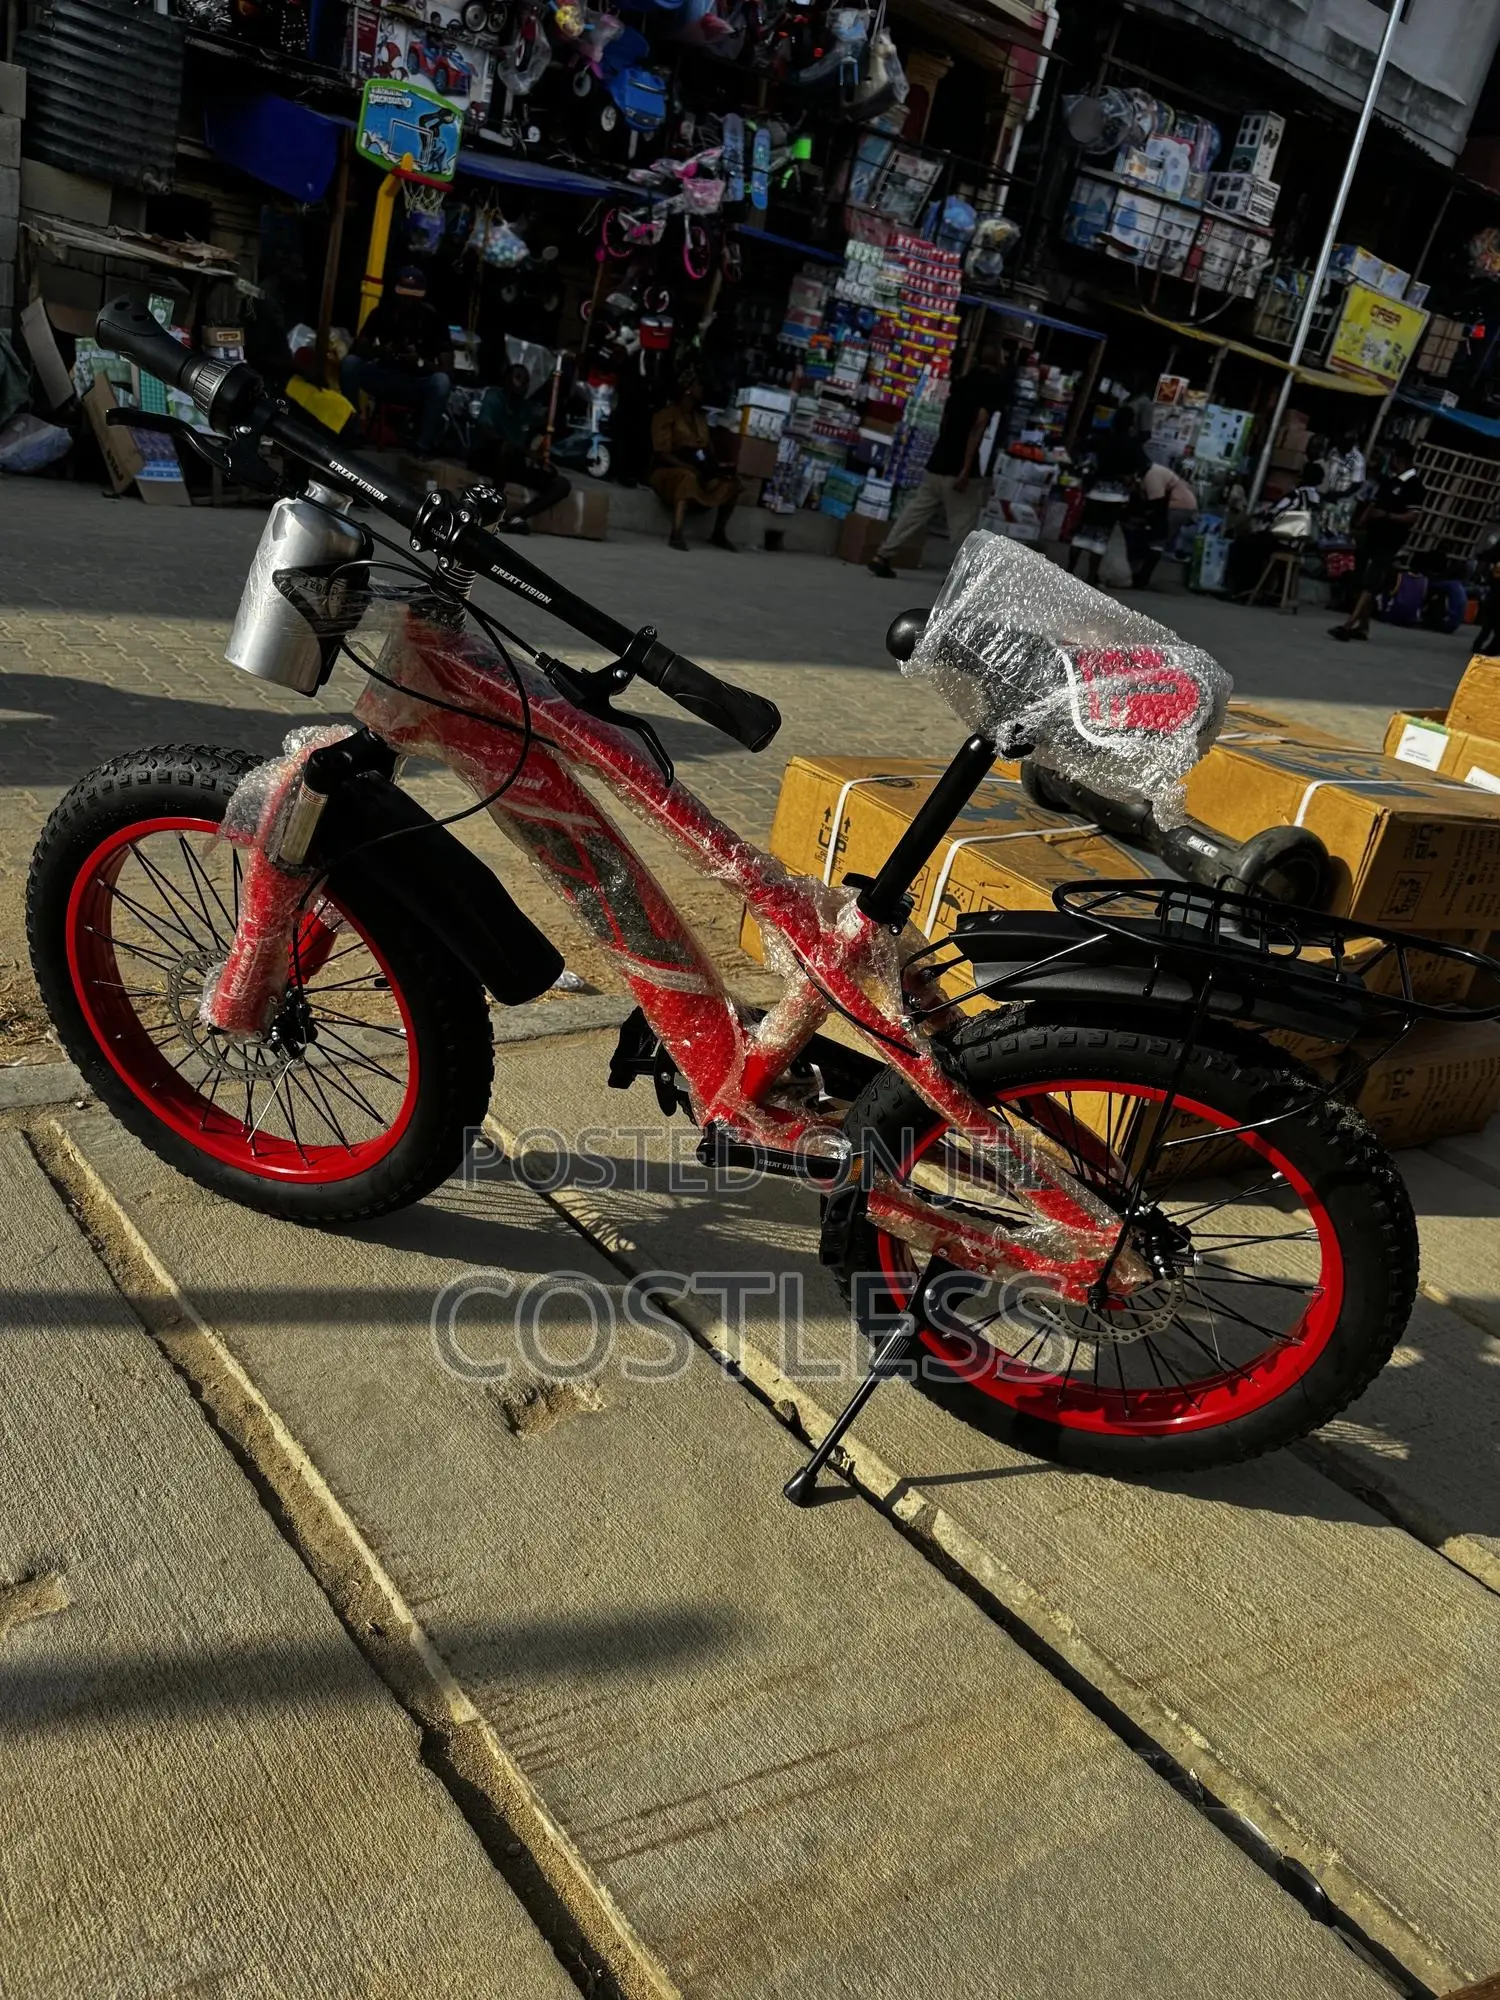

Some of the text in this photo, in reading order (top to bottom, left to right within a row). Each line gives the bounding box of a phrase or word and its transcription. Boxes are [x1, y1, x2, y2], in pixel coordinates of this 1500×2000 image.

[328, 460, 389, 502] GREAT VISION
[490, 564, 553, 604] GREAT VISION
